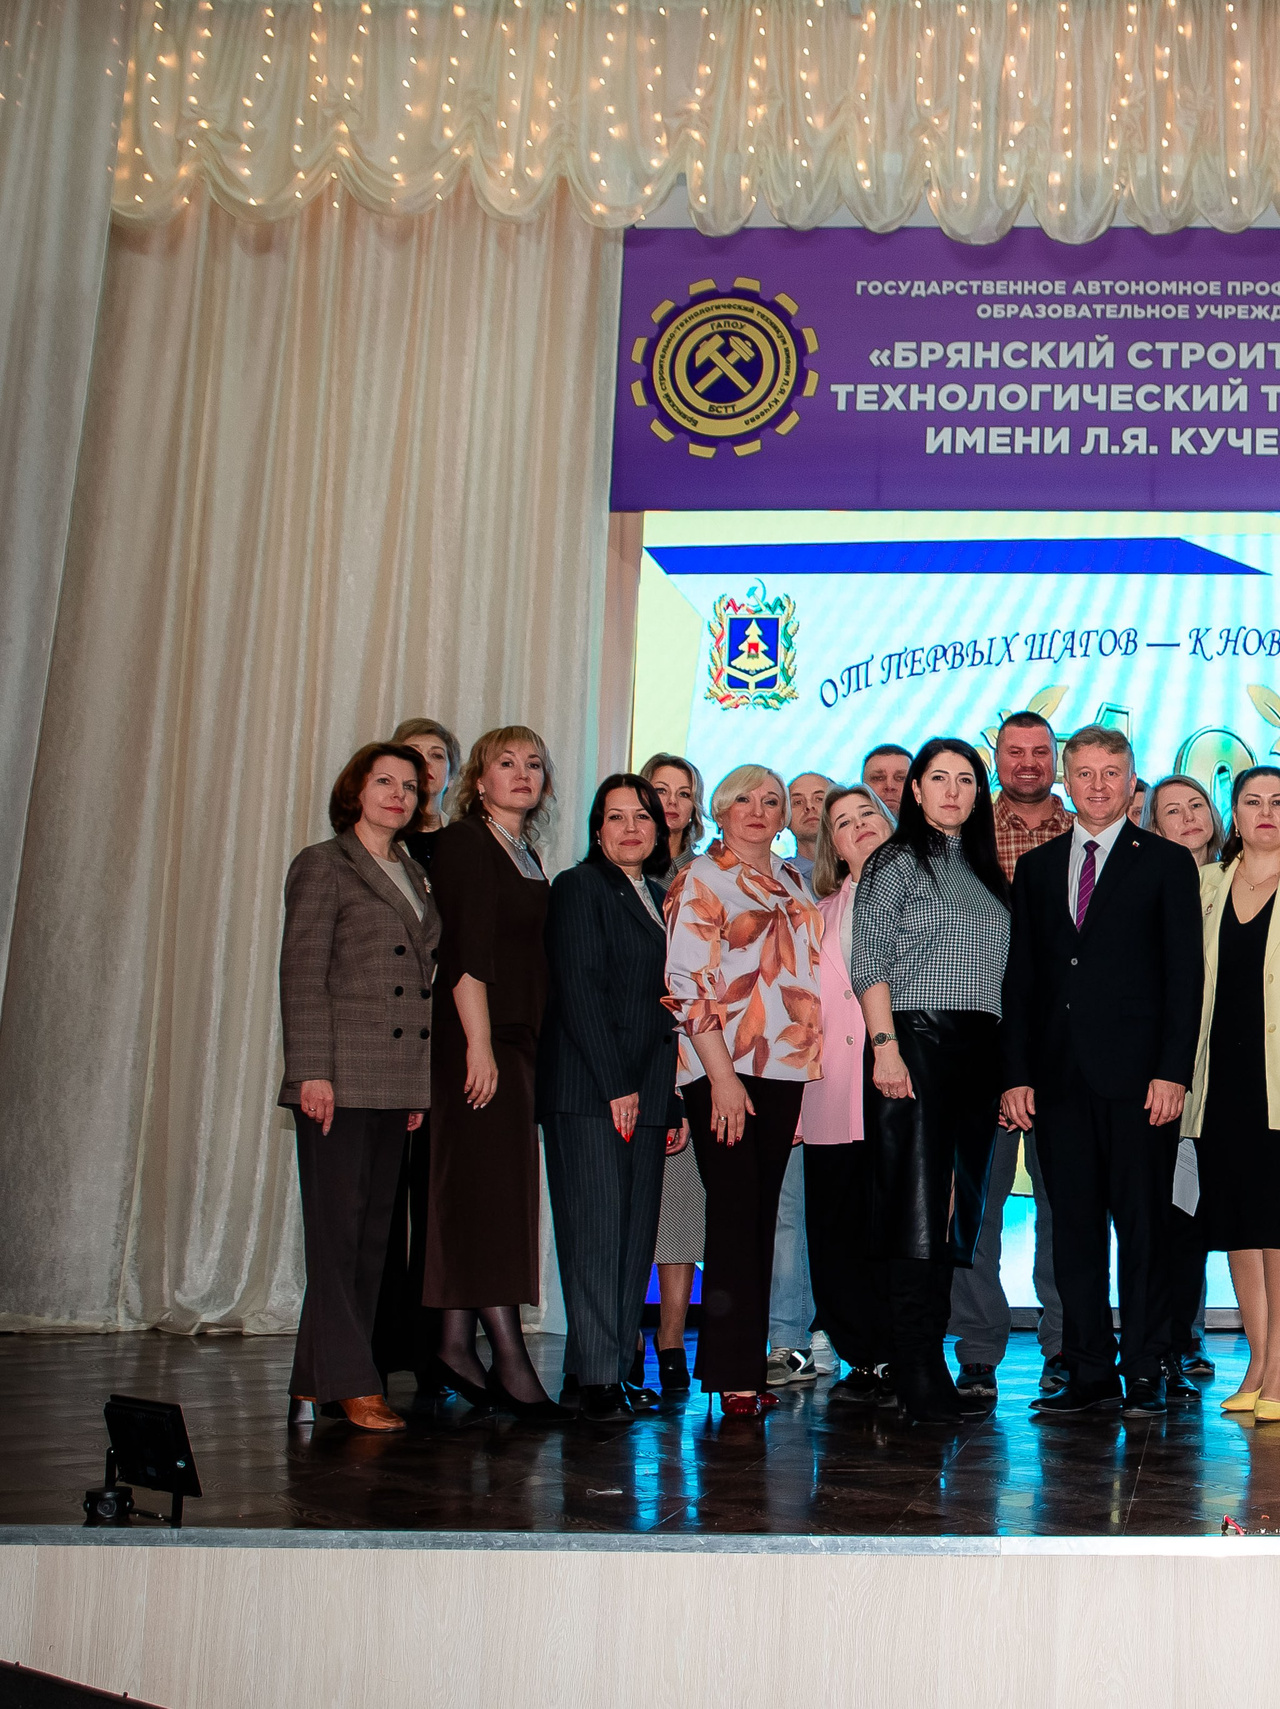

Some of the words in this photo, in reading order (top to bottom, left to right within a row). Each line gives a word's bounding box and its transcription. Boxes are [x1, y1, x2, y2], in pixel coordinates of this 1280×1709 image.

[856, 279, 1067, 298] ГОСУДАРСТВЕННОЕ
[1071, 279, 1222, 297] АВТОНОМНОЕ
[976, 302, 1190, 320] ОБРАЗОВАТЕЛЬНОЕ
[709, 320, 747, 331] ГАПОУ
[868, 333, 1115, 369] «БРЯНСКИЙ
[830, 376, 1248, 412] ТЕХНОЛОГИЧЕСКИЙ
[708, 403, 737, 414] БСТТ
[925, 426, 1070, 456] ИМЕНИ
[1080, 426, 1160, 456] Л.Я.
[819, 654, 875, 708] ОТ
[880, 631, 1021, 685] ПЕРВЫХ
[1024, 627, 1139, 664] ШАГОВ
[1188, 626, 1214, 662] К
